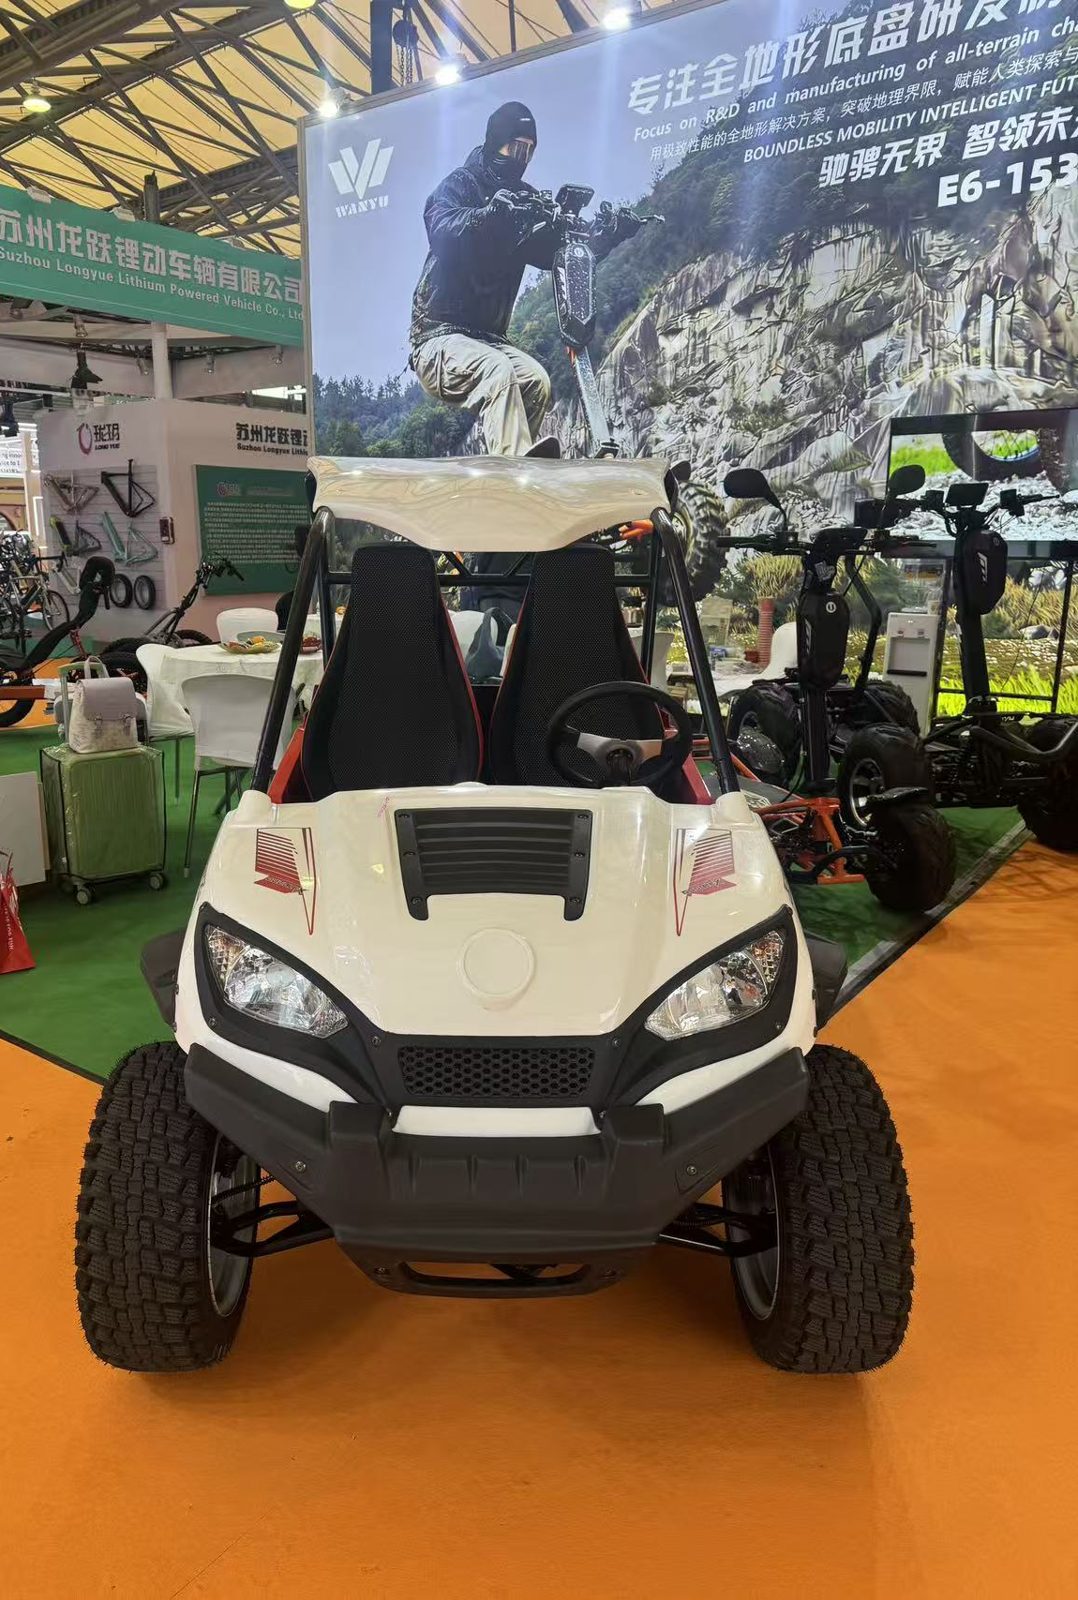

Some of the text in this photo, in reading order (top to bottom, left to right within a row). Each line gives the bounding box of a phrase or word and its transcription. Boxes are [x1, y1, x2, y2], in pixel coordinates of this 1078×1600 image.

[627, 0, 1060, 115] 专注全地形底盘研发
[634, 122, 672, 142] Focus
[680, 115, 698, 130] on
[706, 104, 740, 124] R&D
[748, 92, 777, 114] and
[784, 64, 906, 104] manufacturing
[916, 51, 938, 71] of
[945, 27, 1040, 64] all-terrain
[743, 130, 833, 163] BOUNDLESS
[836, 110, 918, 142] MOBILITY
[920, 84, 1038, 125] INTELLIGENT
[819, 106, 1078, 189] 驰骋无界 智领未
[335, 195, 389, 218] WANYU
[937, 152, 1078, 208] E6-153
[0, 246, 50, 269] Suzhou
[57, 258, 114, 282] Longyue
[118, 272, 166, 293] Lithium
[170, 283, 220, 303] Powered
[224, 294, 262, 313] Vehicle
